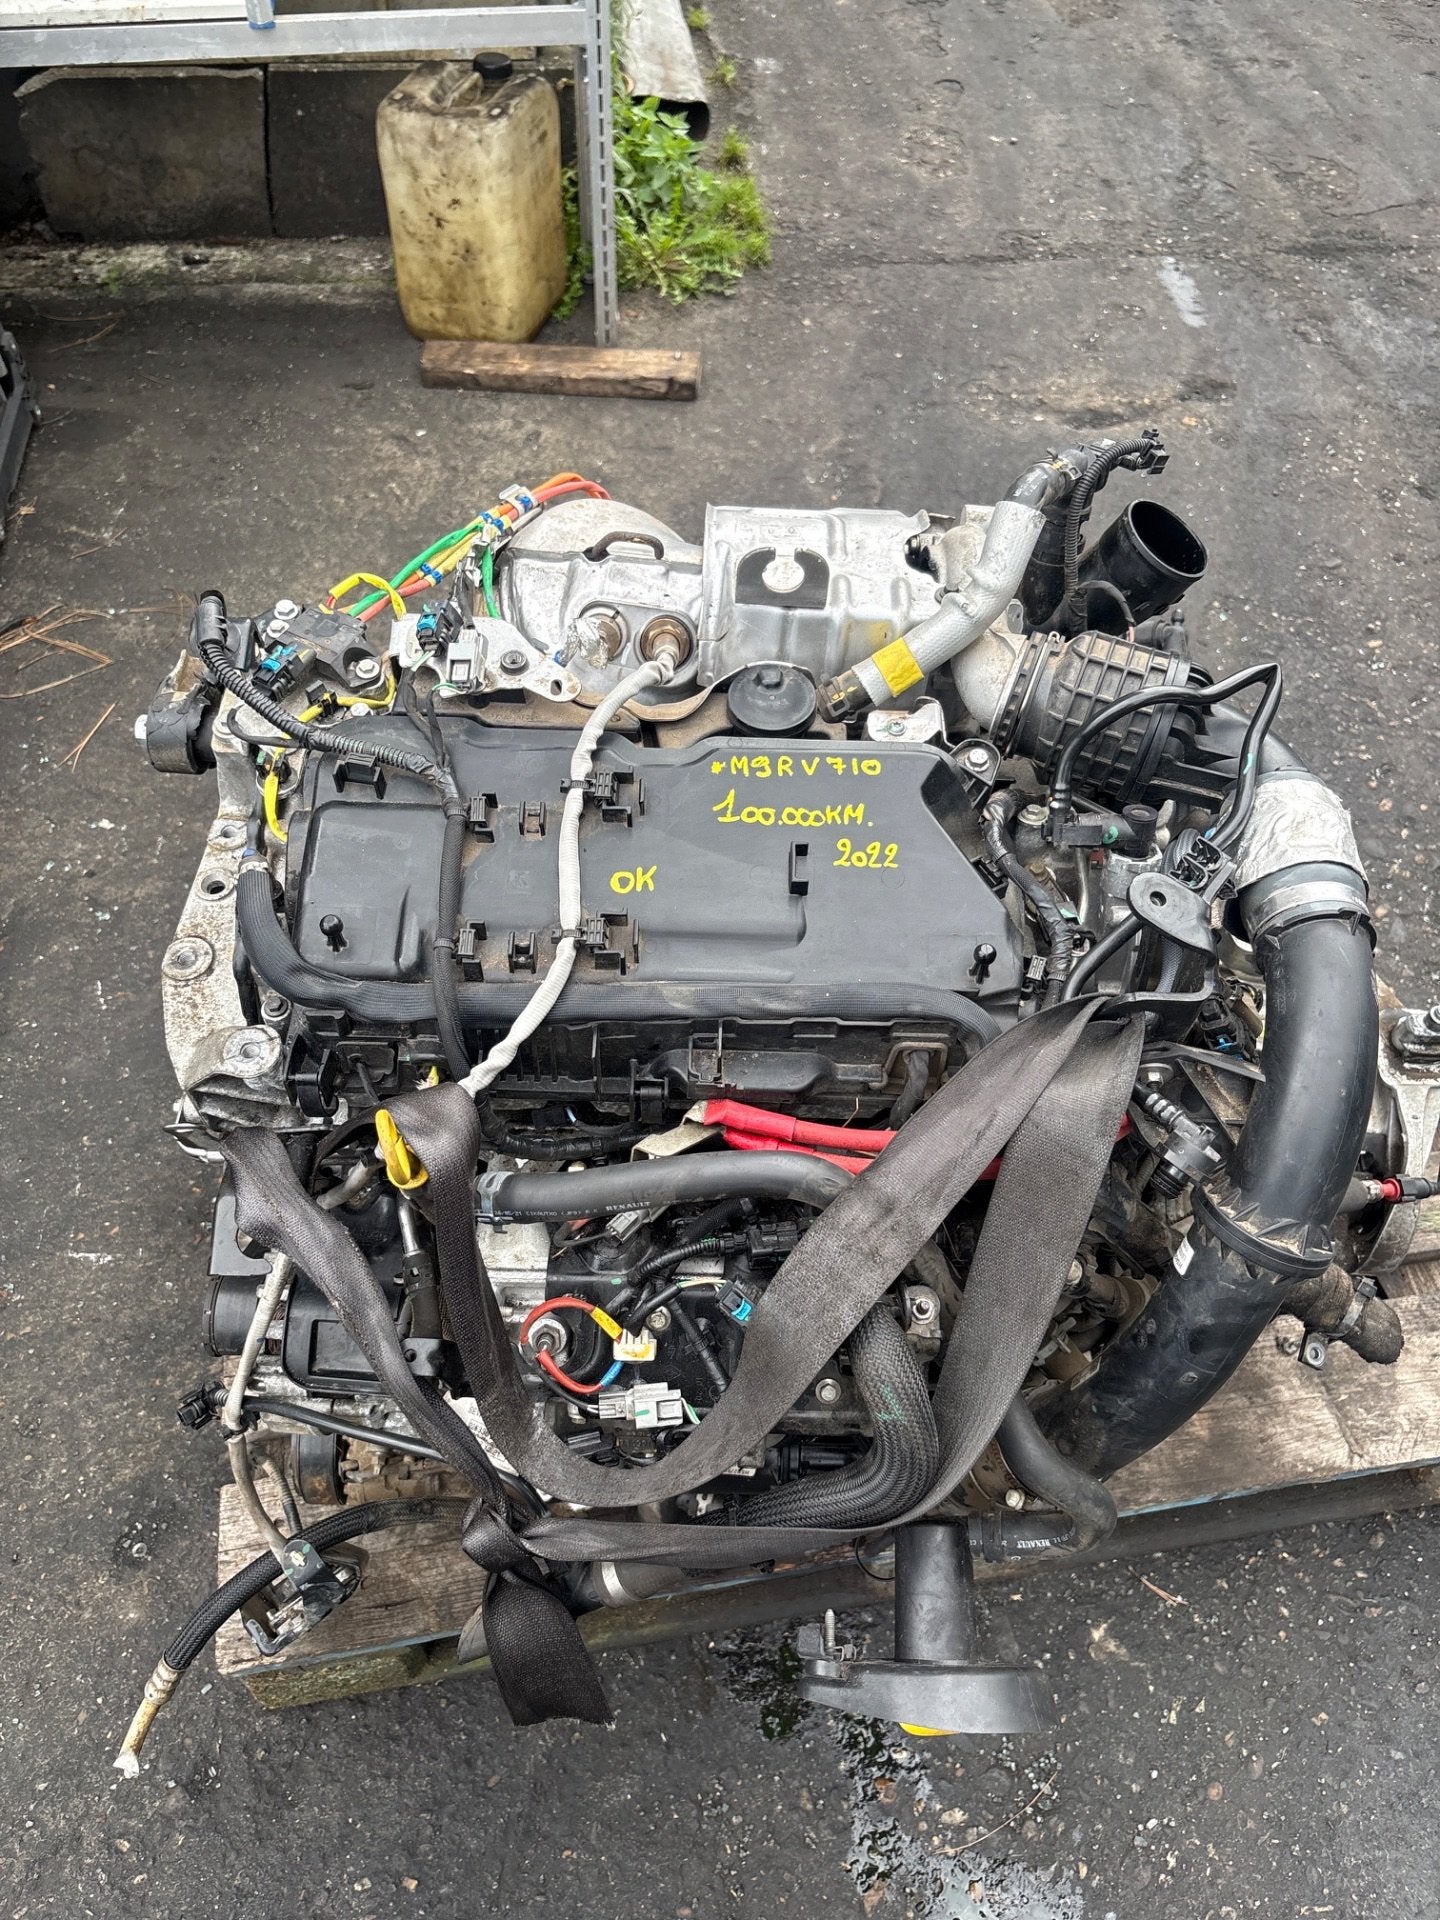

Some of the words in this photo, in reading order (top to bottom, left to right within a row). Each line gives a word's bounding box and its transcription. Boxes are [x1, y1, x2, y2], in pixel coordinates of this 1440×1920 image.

[833, 838, 899, 868] 2022
[609, 866, 657, 893] OK
[605, 1201, 651, 1212] RENAULT
[1016, 1538, 1051, 1549] RENAULT
